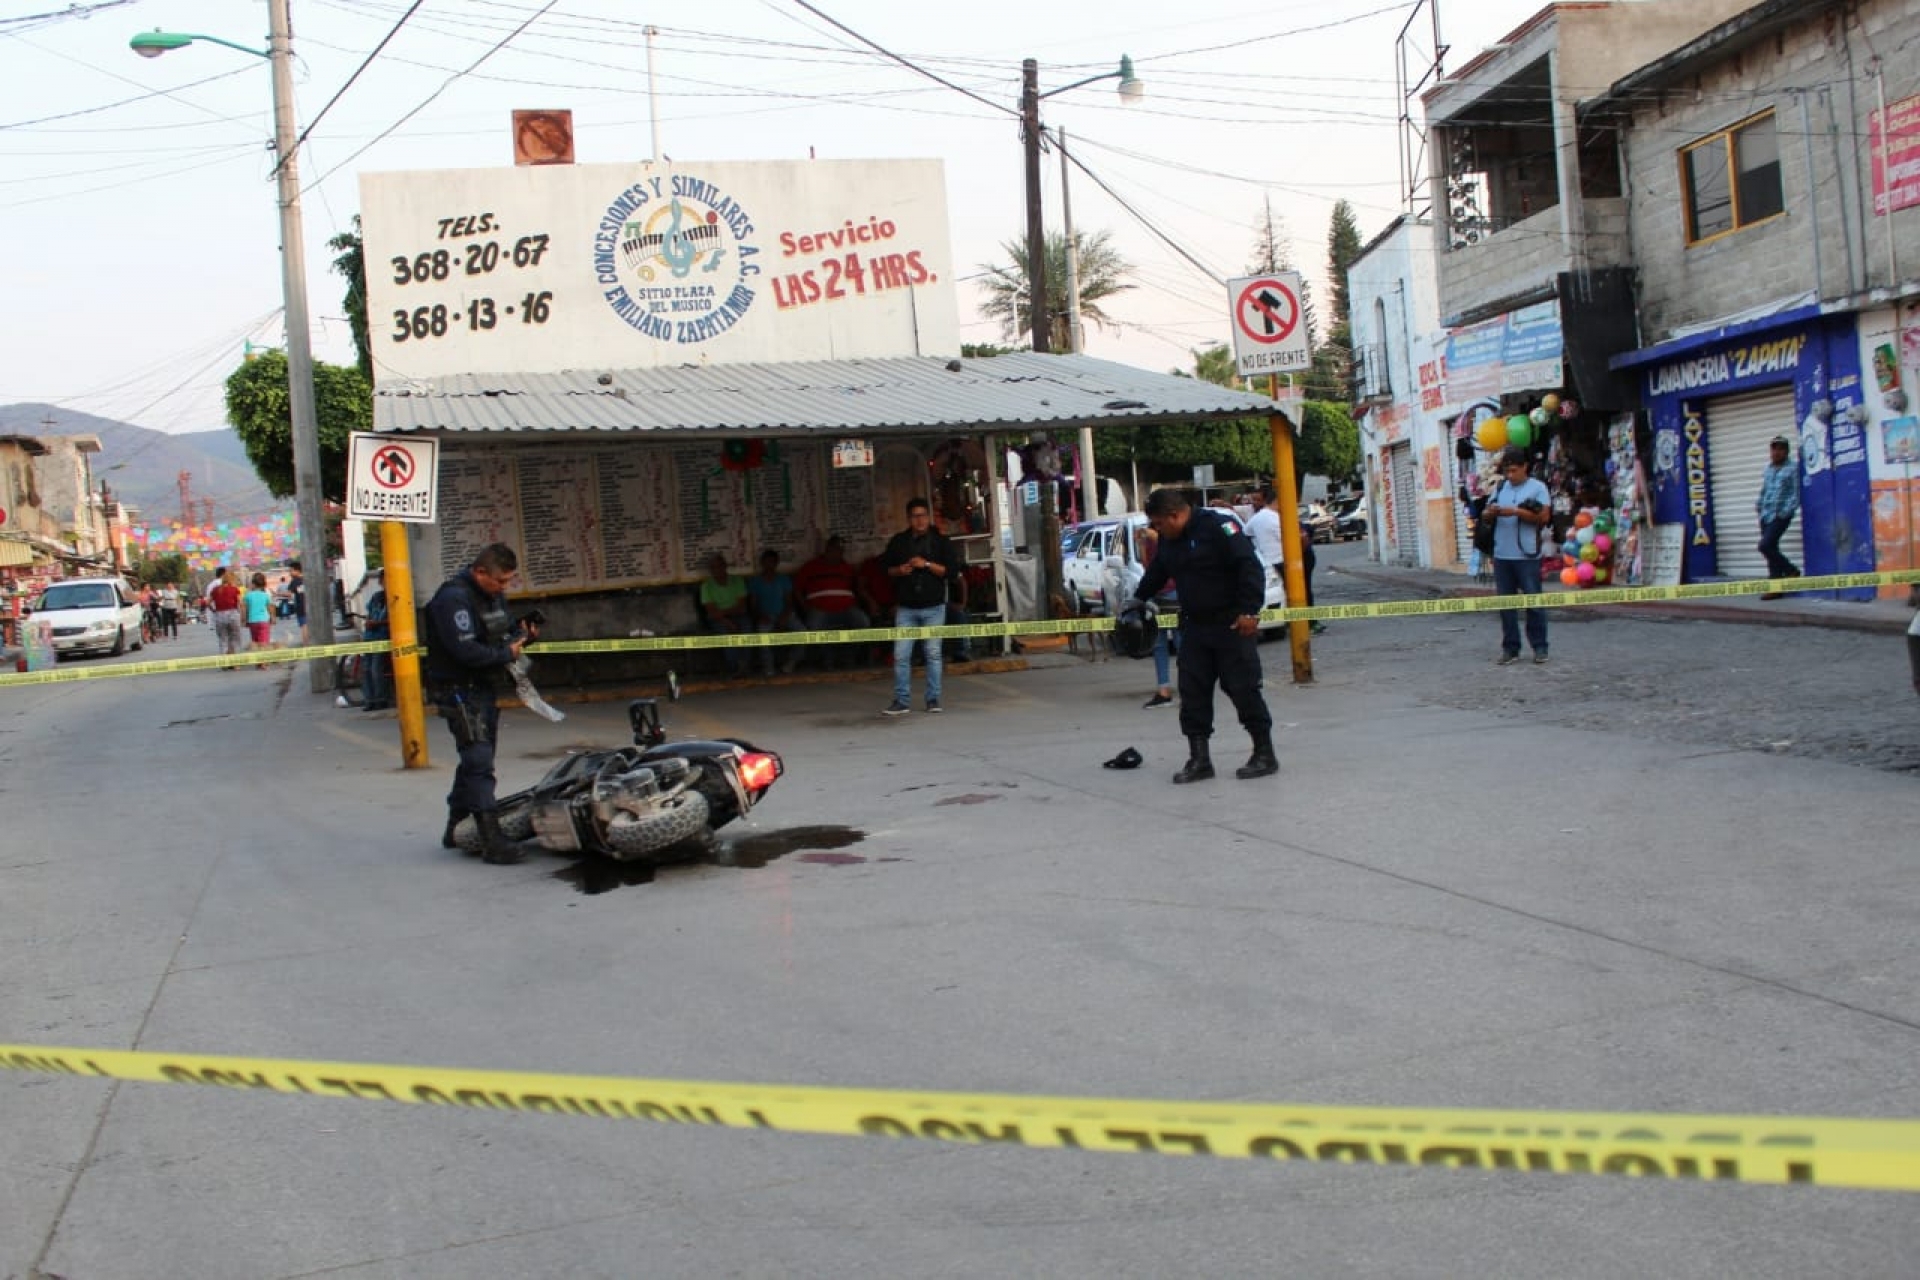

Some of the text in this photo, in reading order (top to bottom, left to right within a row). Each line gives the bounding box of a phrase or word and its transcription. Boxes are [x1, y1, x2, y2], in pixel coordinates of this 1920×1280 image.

[438, 213, 500, 239] TELS.
[594, 174, 761, 284] CONCESIONES Y SIMILARES A.C.
[779, 215, 896, 256] Servicio
[639, 285, 716, 300] SITIO PLAZA
[771, 250, 938, 309] LAS 24 HRS.
[604, 285, 672, 341] EMILIANO
[677, 305, 739, 343] ZAPATA
[649, 299, 712, 313] DEL MUSICO
[1242, 349, 1306, 369] NO DE FRENTE
[1650, 353, 1729, 396] LAVANDERIA
[1683, 401, 1710, 545] LAVANDERIA
[356, 487, 427, 512] NO DE FRENTE
